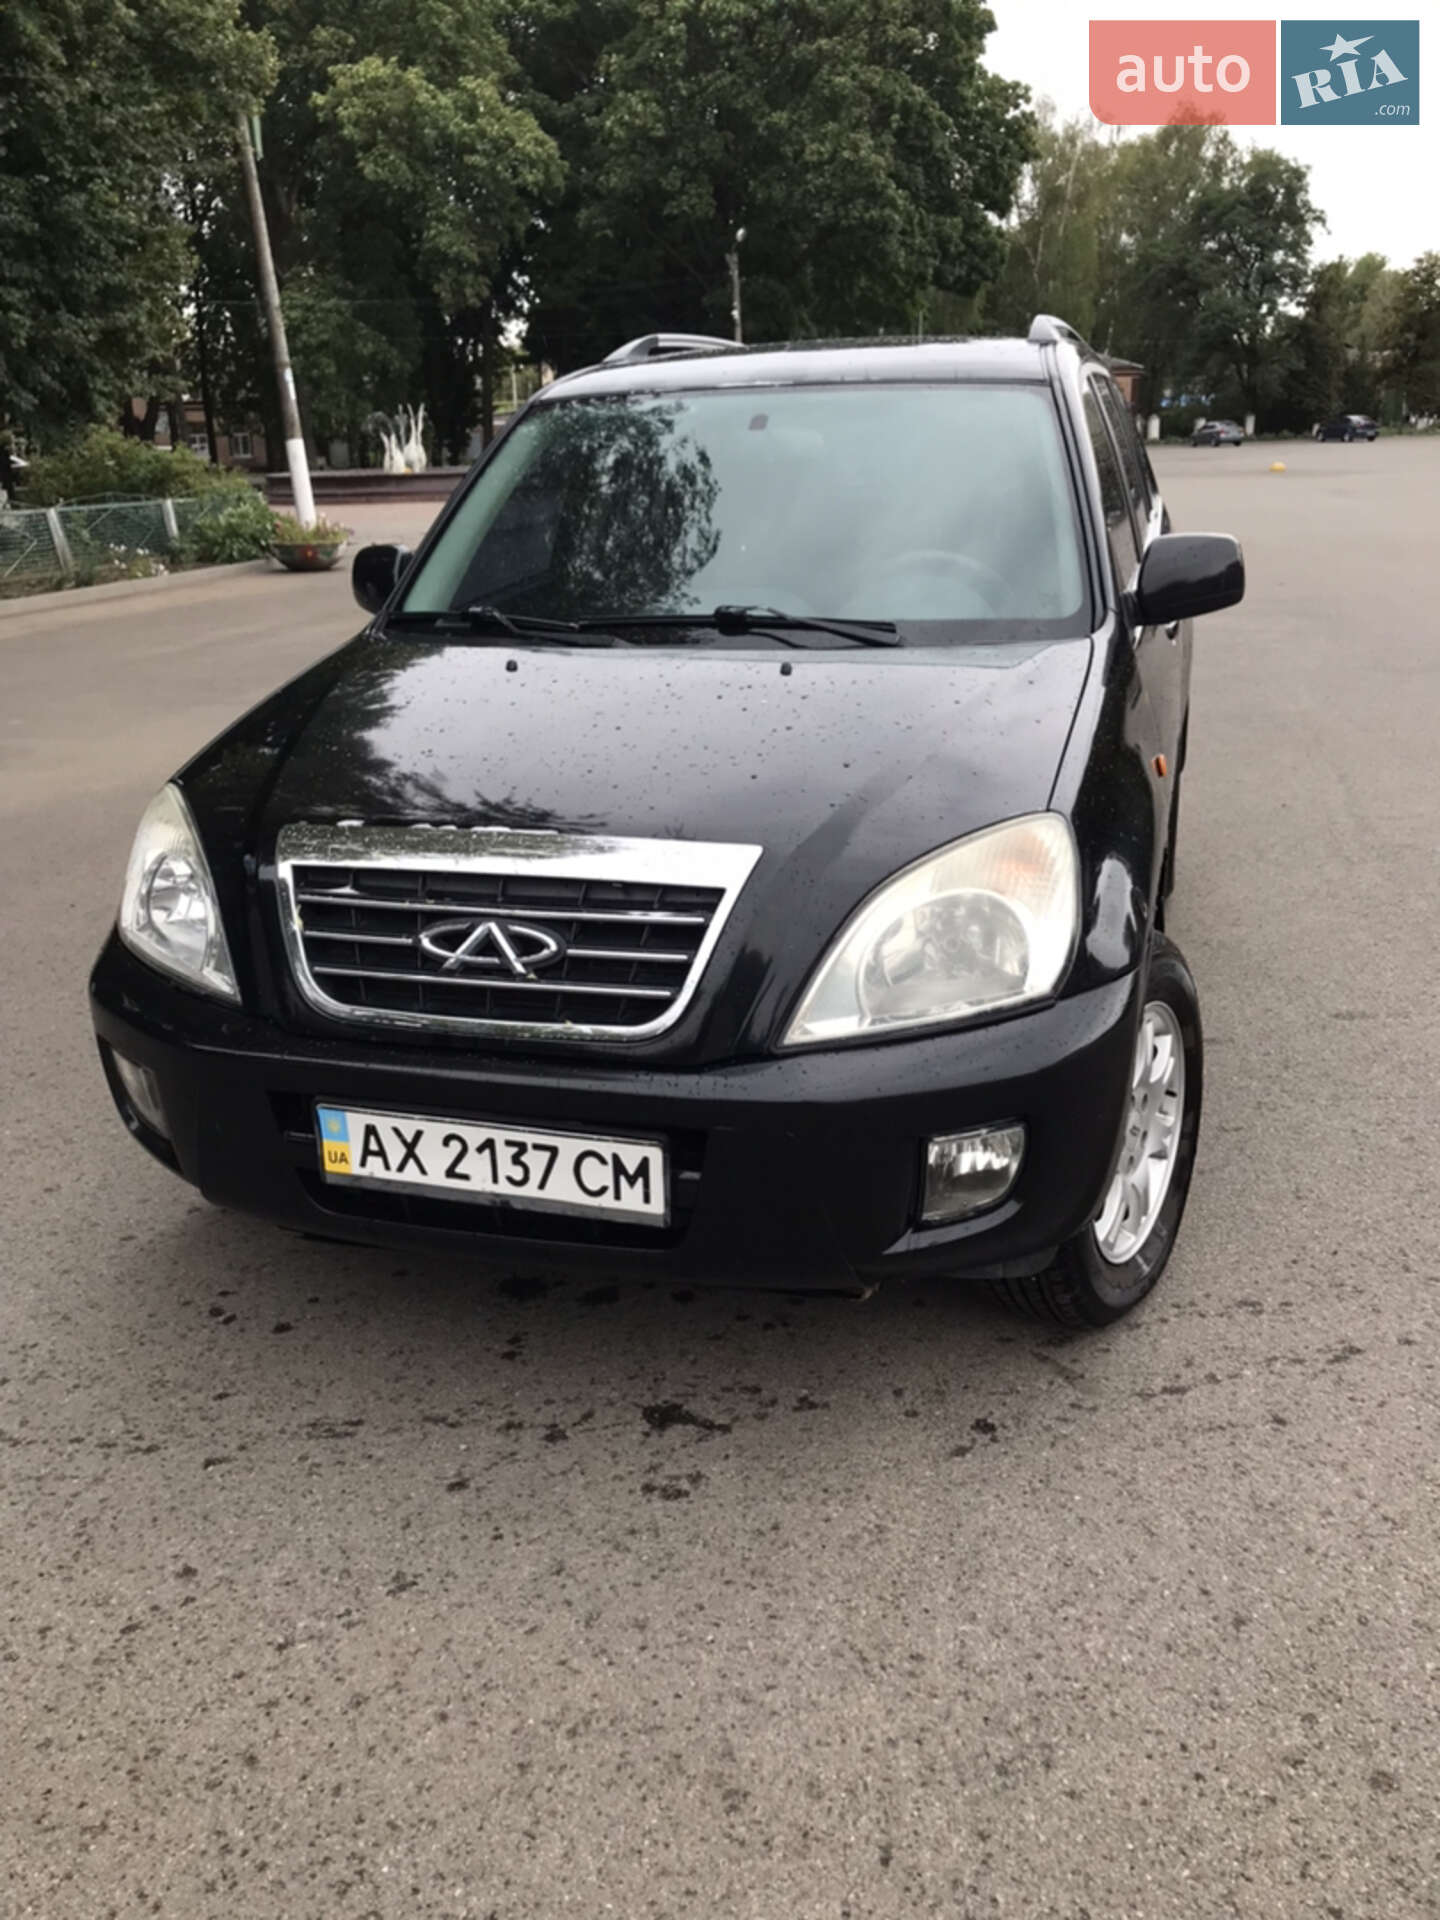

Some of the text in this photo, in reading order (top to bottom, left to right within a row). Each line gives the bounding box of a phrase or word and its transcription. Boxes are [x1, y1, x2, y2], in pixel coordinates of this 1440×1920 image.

[328, 1149, 349, 1165] UA
[359, 1123, 651, 1205] AX 2137 CM
